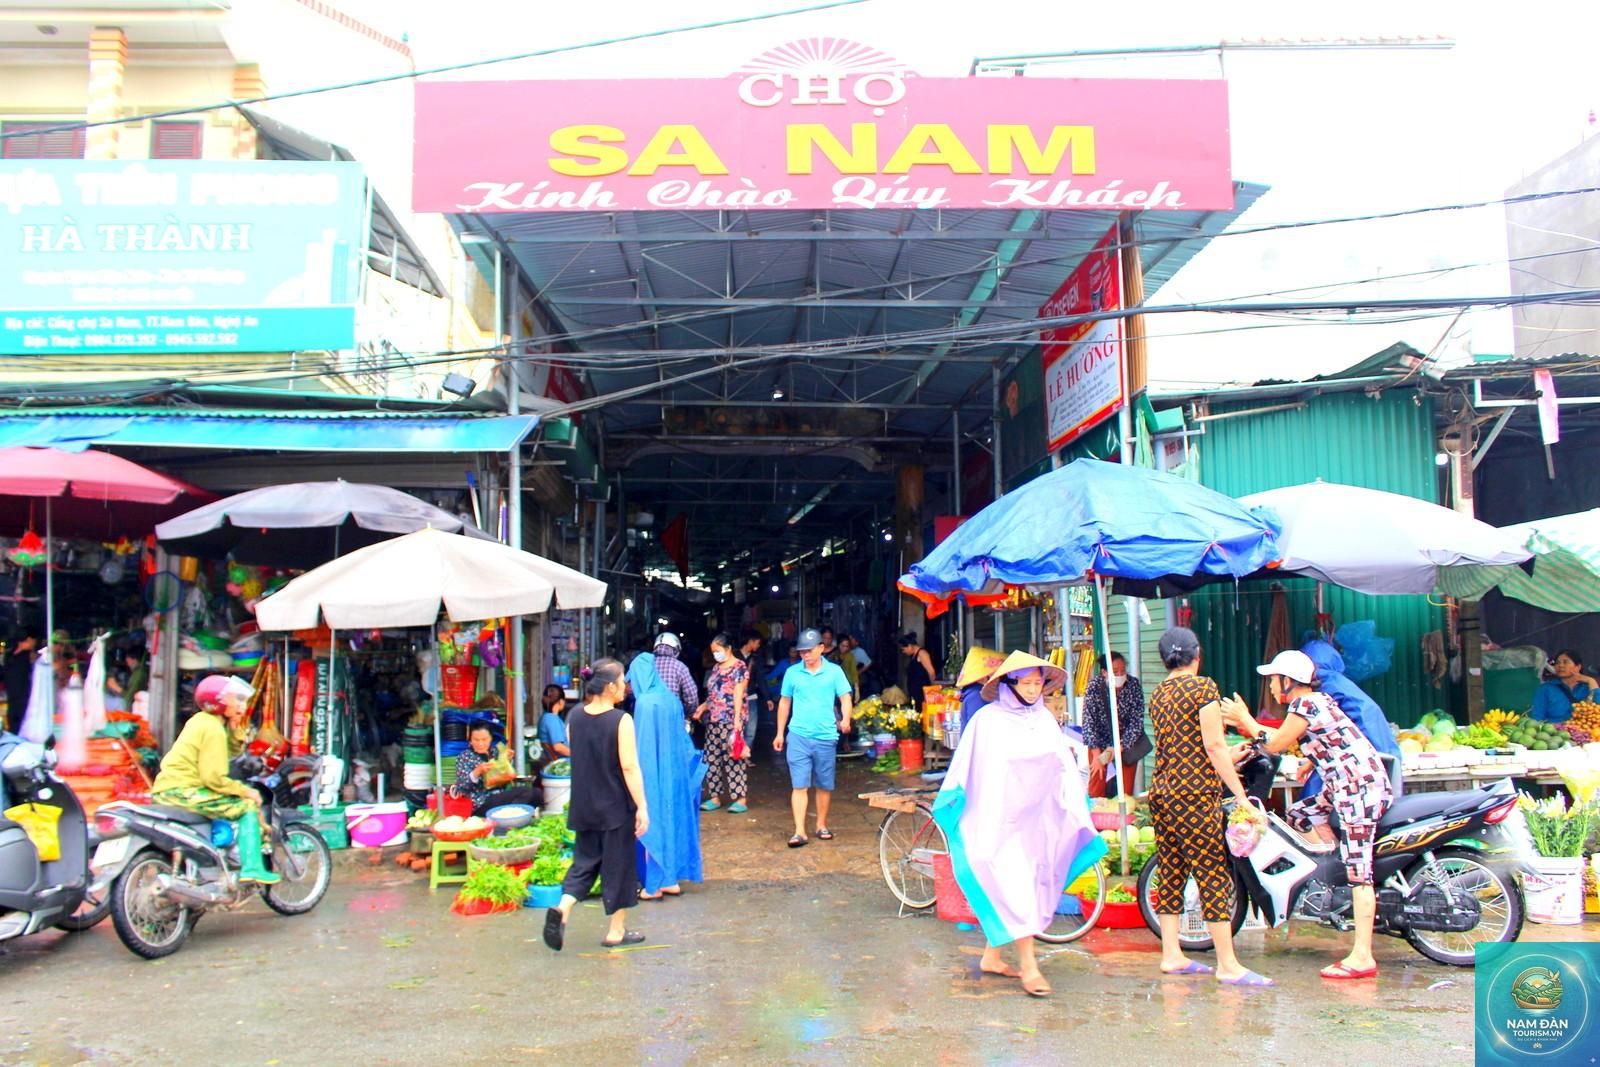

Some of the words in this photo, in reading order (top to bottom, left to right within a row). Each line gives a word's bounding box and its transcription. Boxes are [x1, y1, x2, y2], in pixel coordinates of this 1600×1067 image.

[738, 72, 906, 117] CHỢ
[547, 124, 729, 178] SA
[786, 123, 1097, 177] NAM
[456, 180, 618, 212] Kính
[647, 176, 798, 208] Chào
[982, 178, 1187, 211] Khách
[20, 217, 84, 252] HÀ
[98, 214, 251, 252] THÀNH
